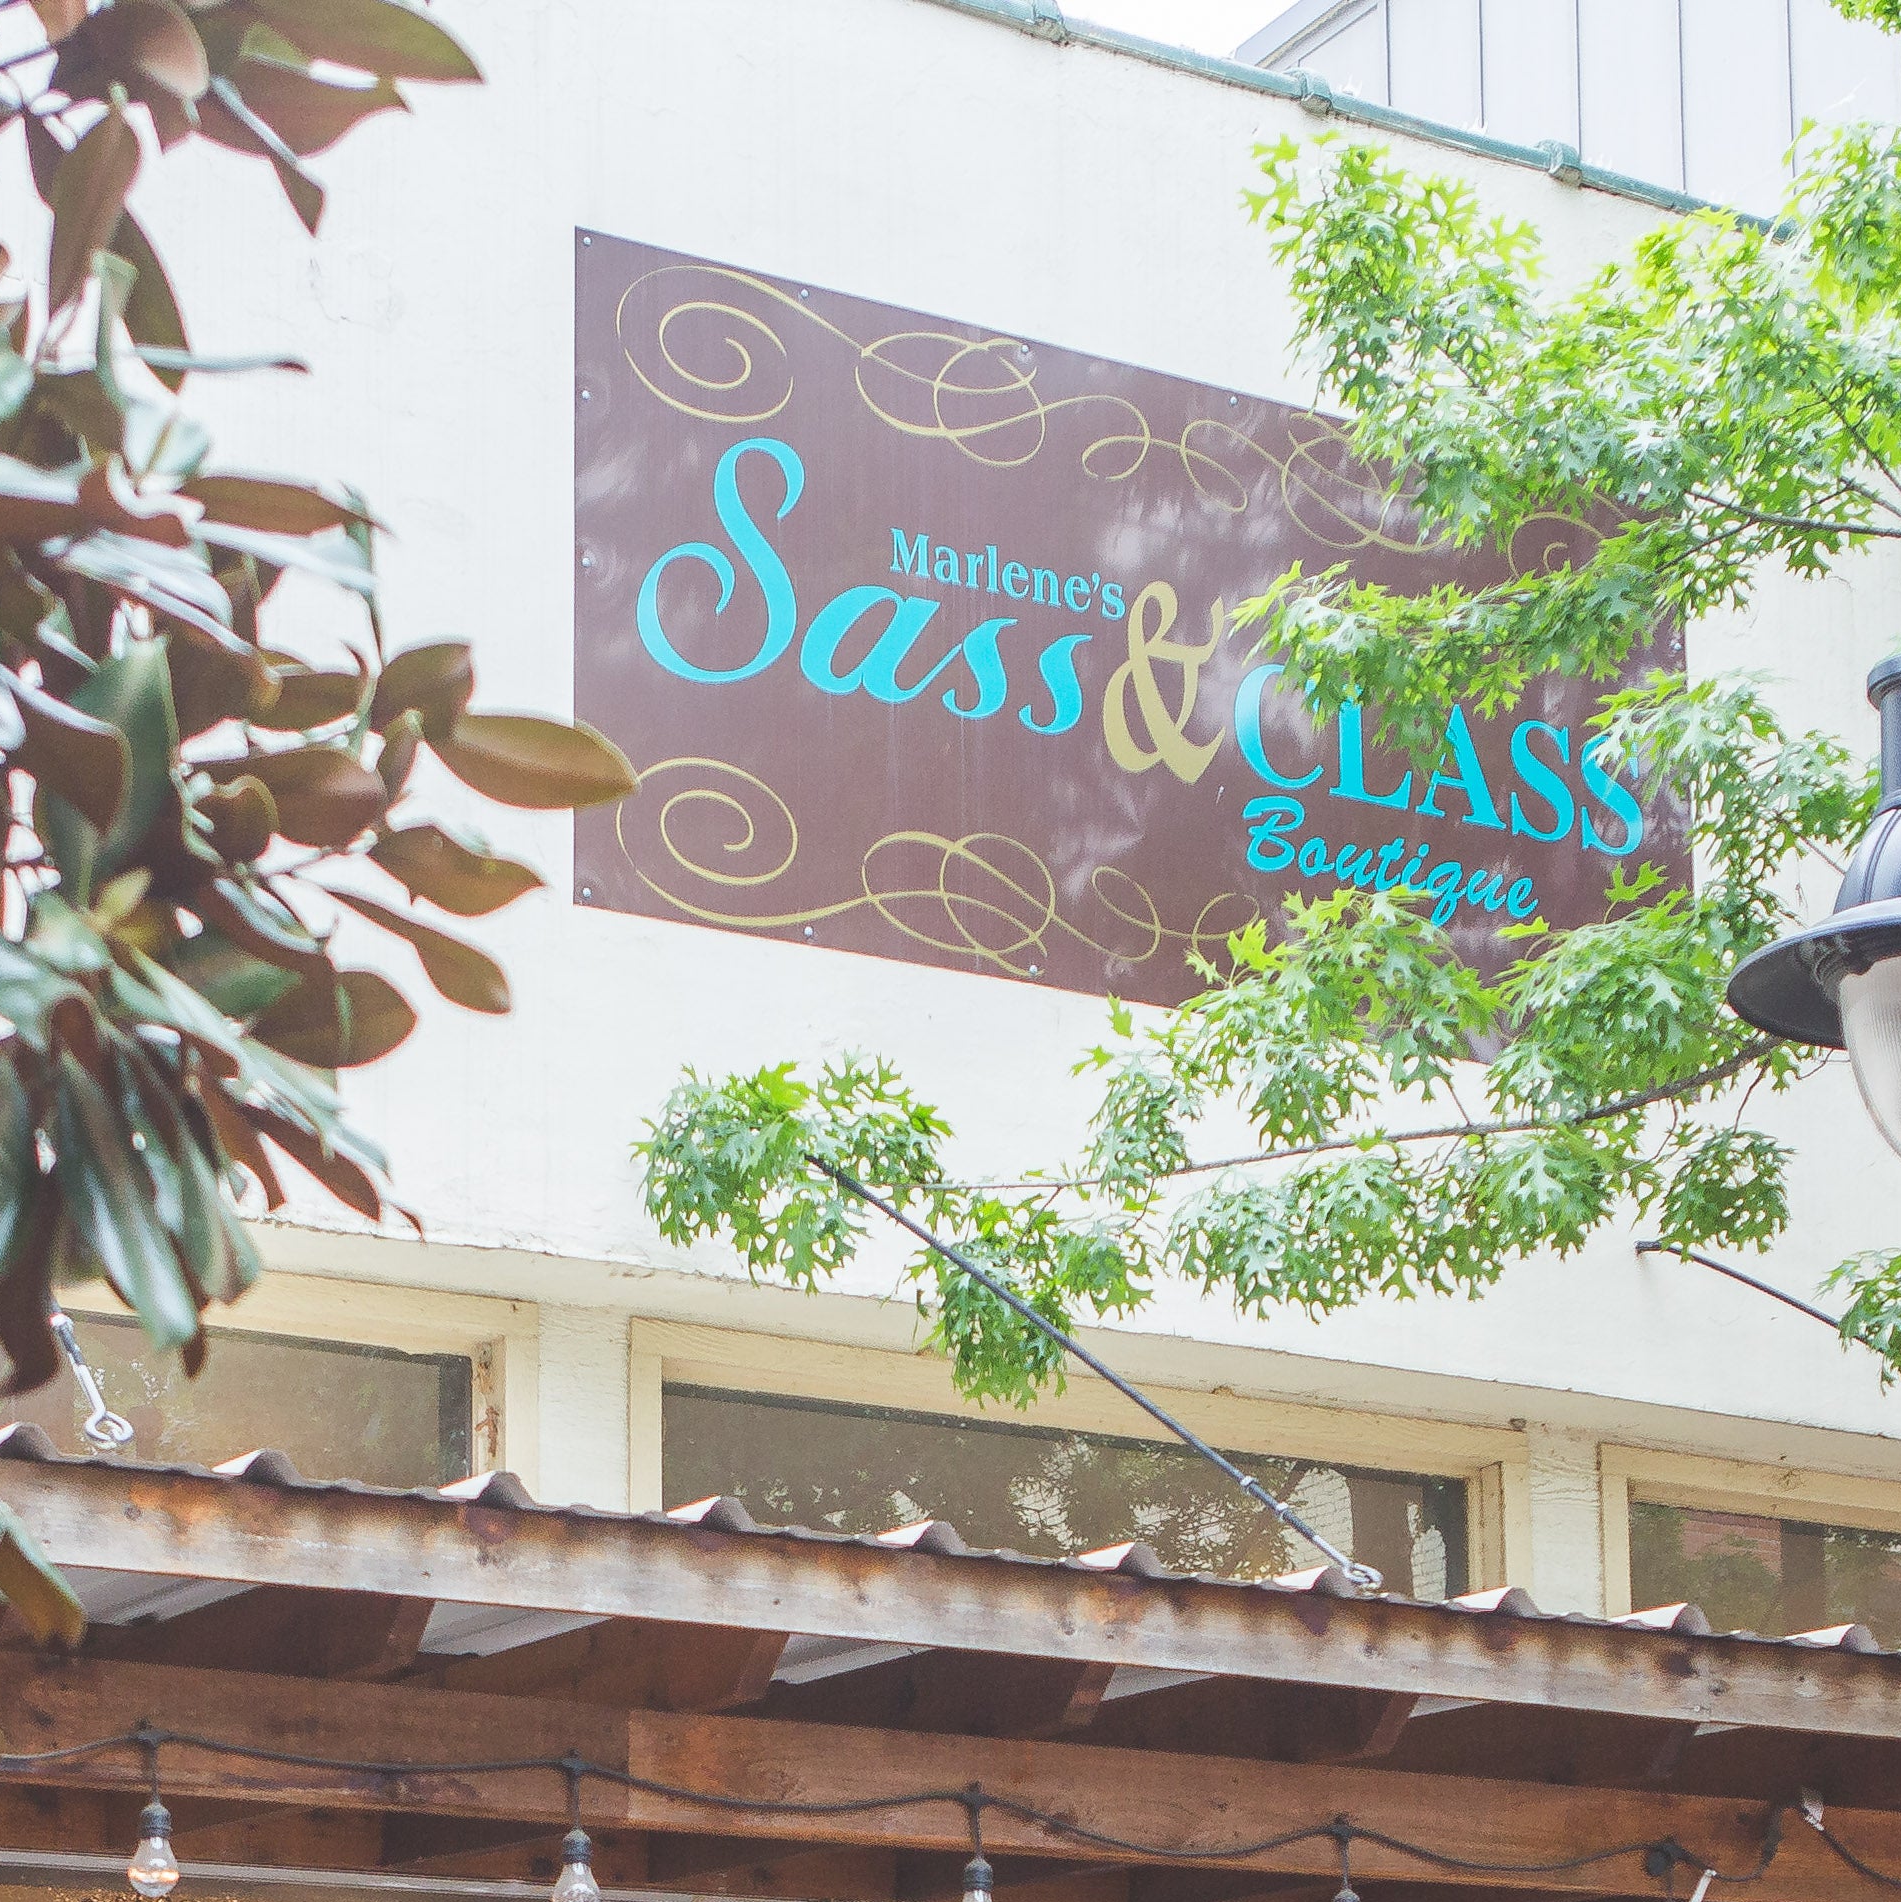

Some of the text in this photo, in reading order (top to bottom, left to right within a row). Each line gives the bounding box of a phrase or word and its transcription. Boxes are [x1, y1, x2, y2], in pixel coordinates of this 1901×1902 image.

[888, 526, 1126, 620] Marlene's
[636, 437, 1645, 858] Sass & CLASS
[1242, 795, 1539, 930] Boutique
